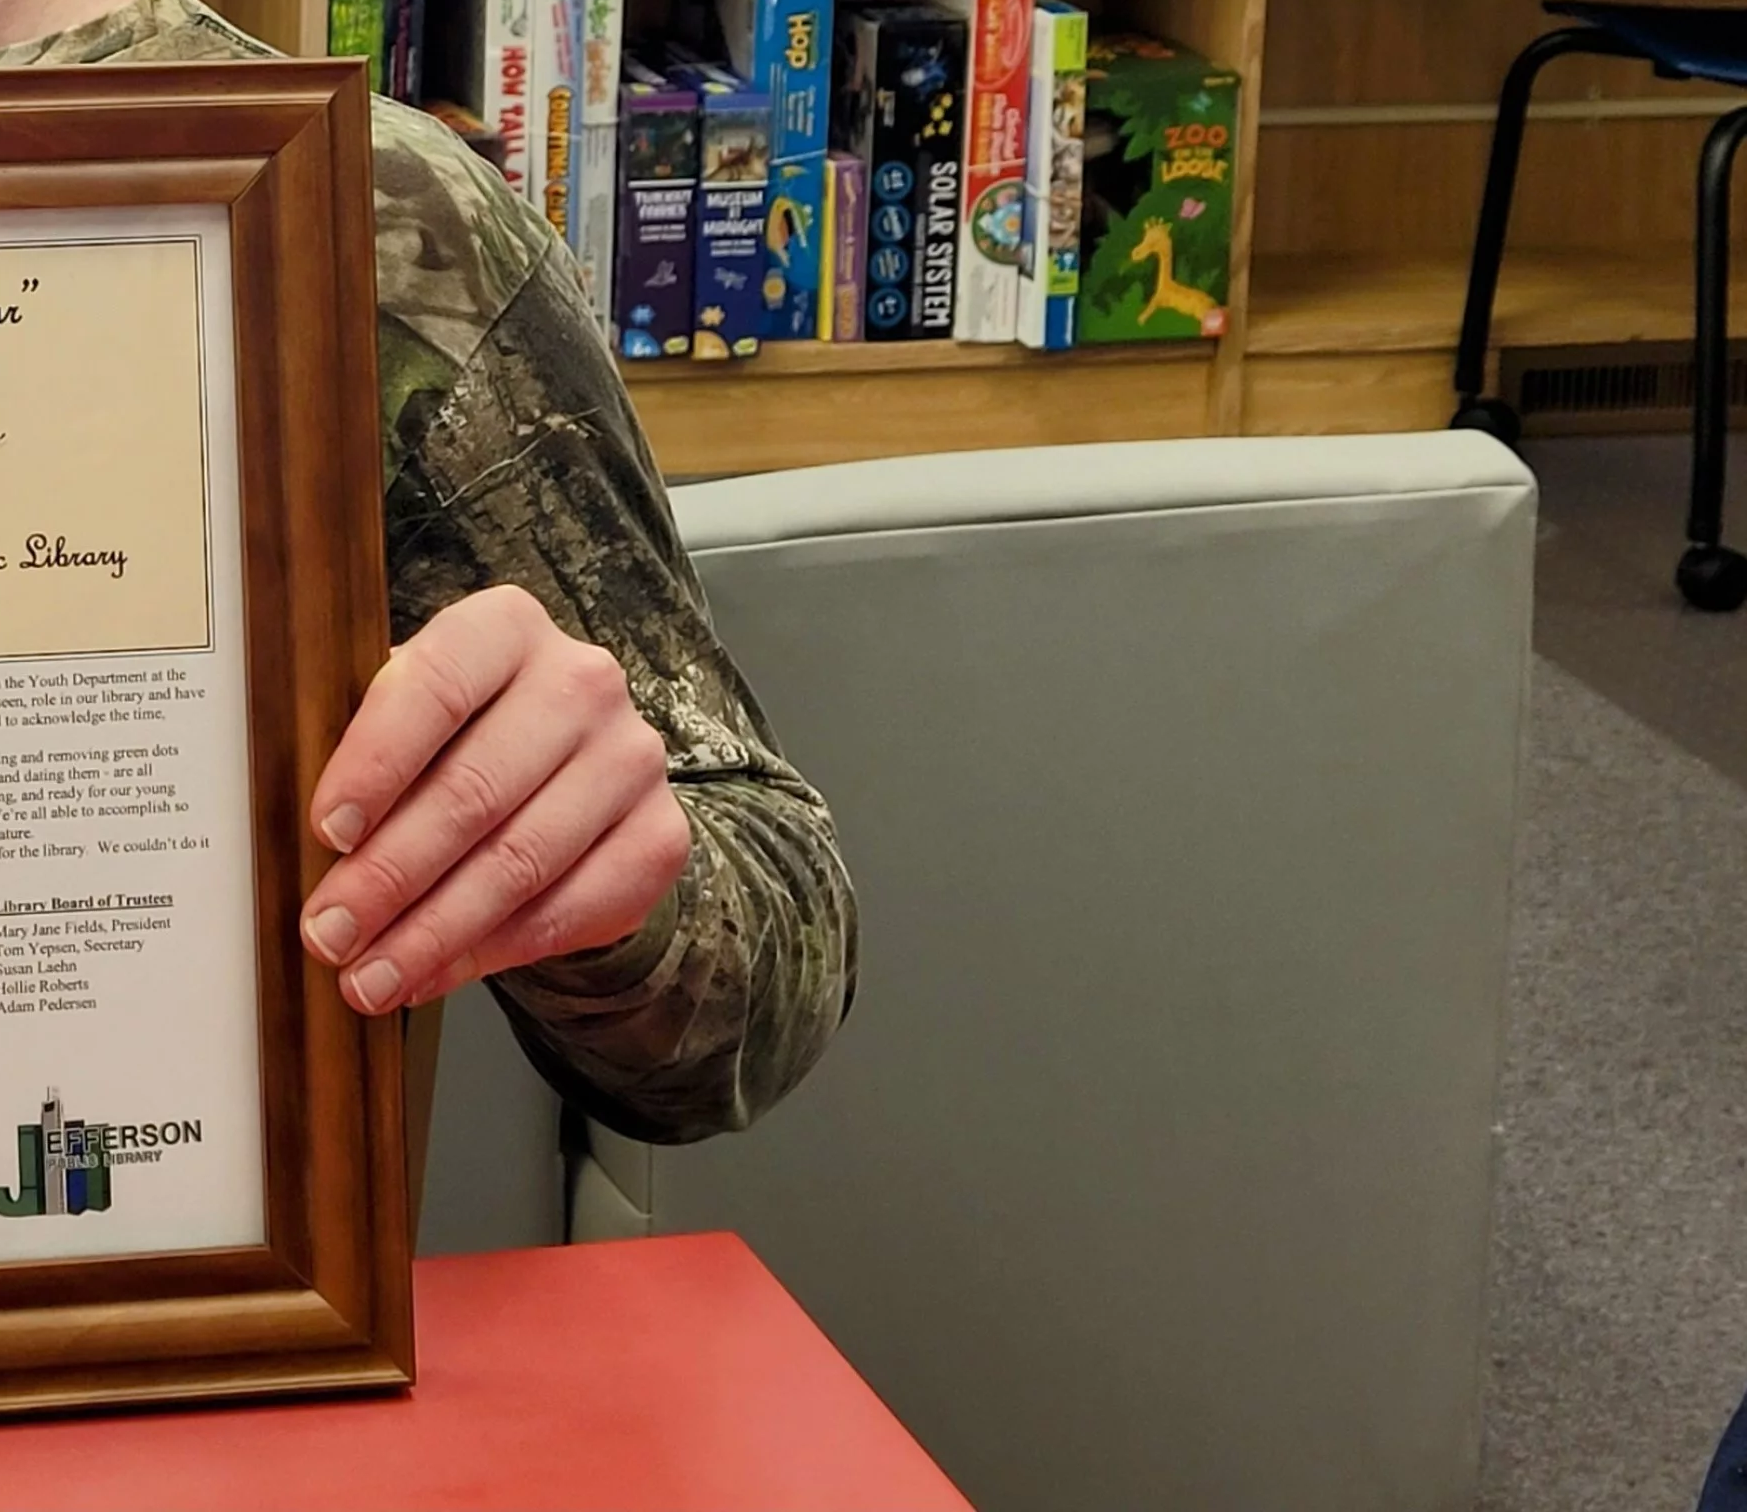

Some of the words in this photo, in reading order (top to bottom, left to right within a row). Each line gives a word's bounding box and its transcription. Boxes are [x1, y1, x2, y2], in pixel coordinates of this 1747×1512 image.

[500, 45, 527, 95] HOW
[499, 104, 526, 158] TALL
[1164, 123, 1229, 149] ZOO
[1160, 160, 1229, 184] LOOSE
[928, 160, 958, 236] SOLAR
[922, 242, 951, 328] SYSTEM
[19, 533, 128, 579] Library
[4, 675, 25, 689] the
[28, 674, 68, 688] Youth
[72, 671, 147, 688] Department
[151, 669, 164, 682] at
[166, 668, 187, 681] the
[51, 896, 94, 911] Board
[97, 895, 112, 908] of
[115, 893, 174, 907] Trustees
[32, 923, 61, 937] Jane
[65, 920, 108, 935] Fields,
[111, 917, 172, 931] President
[28, 942, 81, 958] Yepsen,
[83, 938, 144, 952] Secretary
[103, 1149, 164, 1167] LIBRARY
